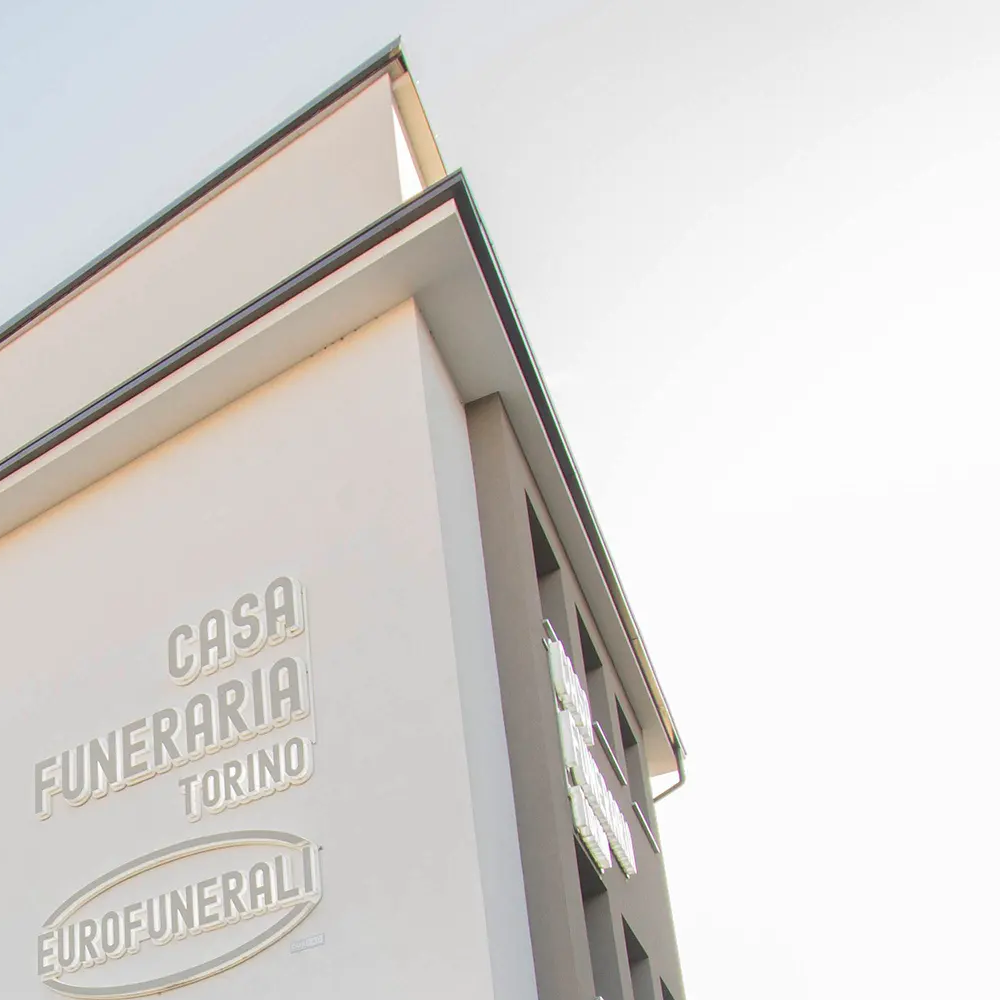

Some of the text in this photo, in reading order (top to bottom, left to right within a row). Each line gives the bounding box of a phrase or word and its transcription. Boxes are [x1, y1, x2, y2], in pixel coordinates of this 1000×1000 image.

[167, 575, 304, 681] CASA
[34, 656, 306, 817] FUNERARIA
[178, 736, 309, 819] TORINO
[37, 846, 317, 976] EUROFUNERALI
